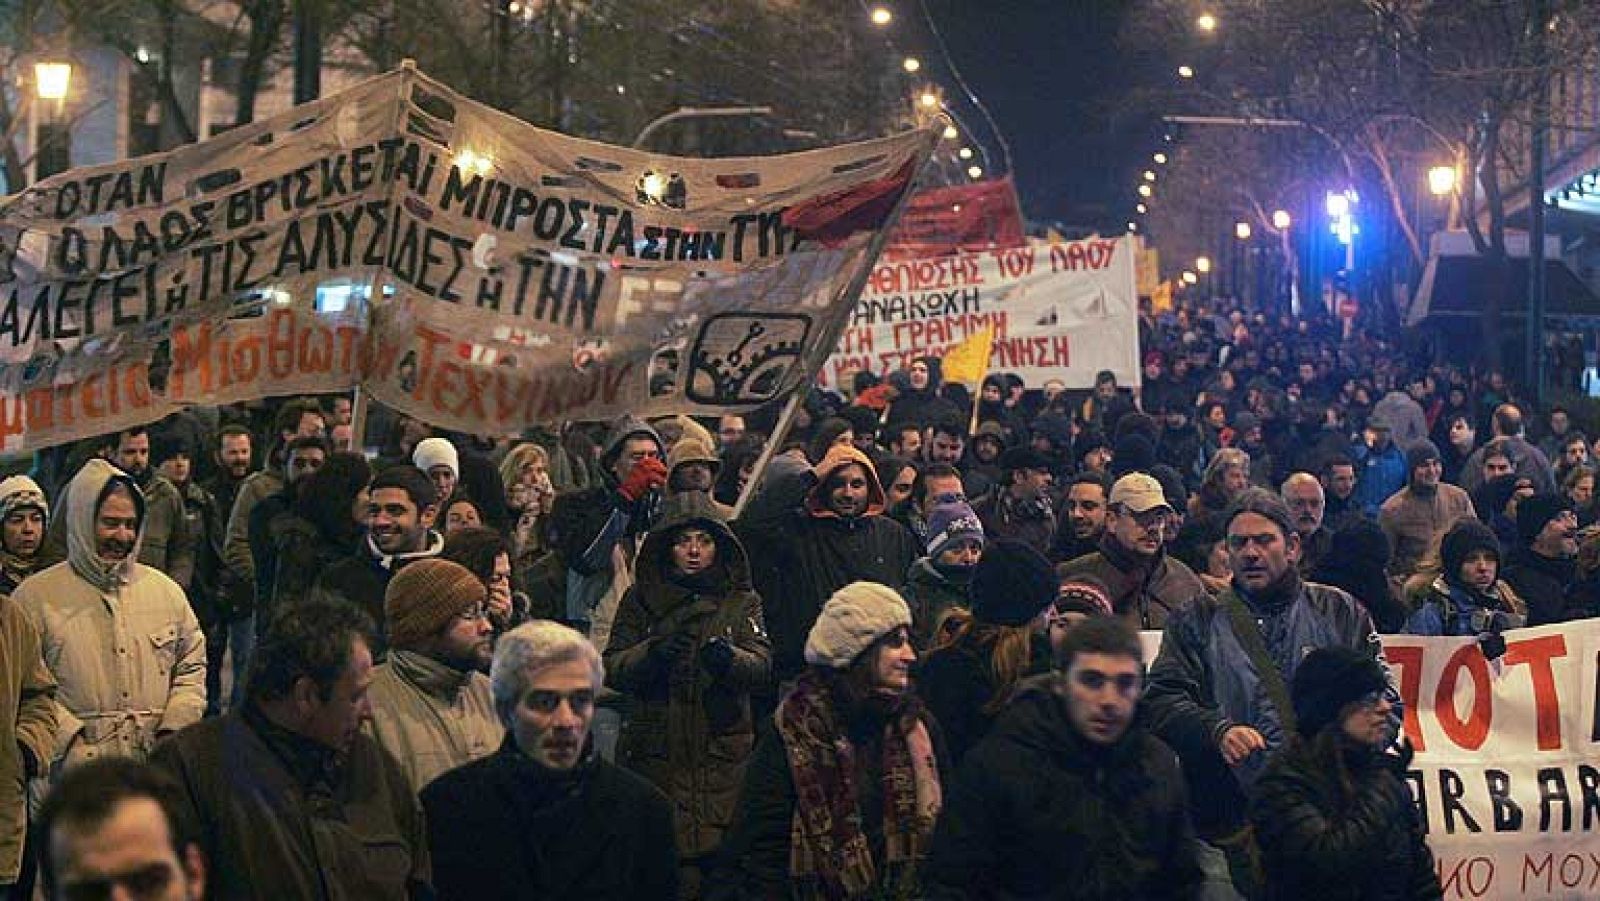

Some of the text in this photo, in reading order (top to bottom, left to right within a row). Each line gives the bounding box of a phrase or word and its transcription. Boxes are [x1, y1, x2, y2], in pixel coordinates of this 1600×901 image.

[440, 163, 636, 258] ΜΠΡΟΣΤΑ
[639, 225, 727, 262] ΣΤΗΝ
[192, 229, 268, 300] ΤΙΣ
[275, 200, 475, 303] ΑΛΥΣΙΔΕΣ
[514, 256, 607, 332] ΤΗΝ
[992, 248, 1036, 278] ΤΟΥ
